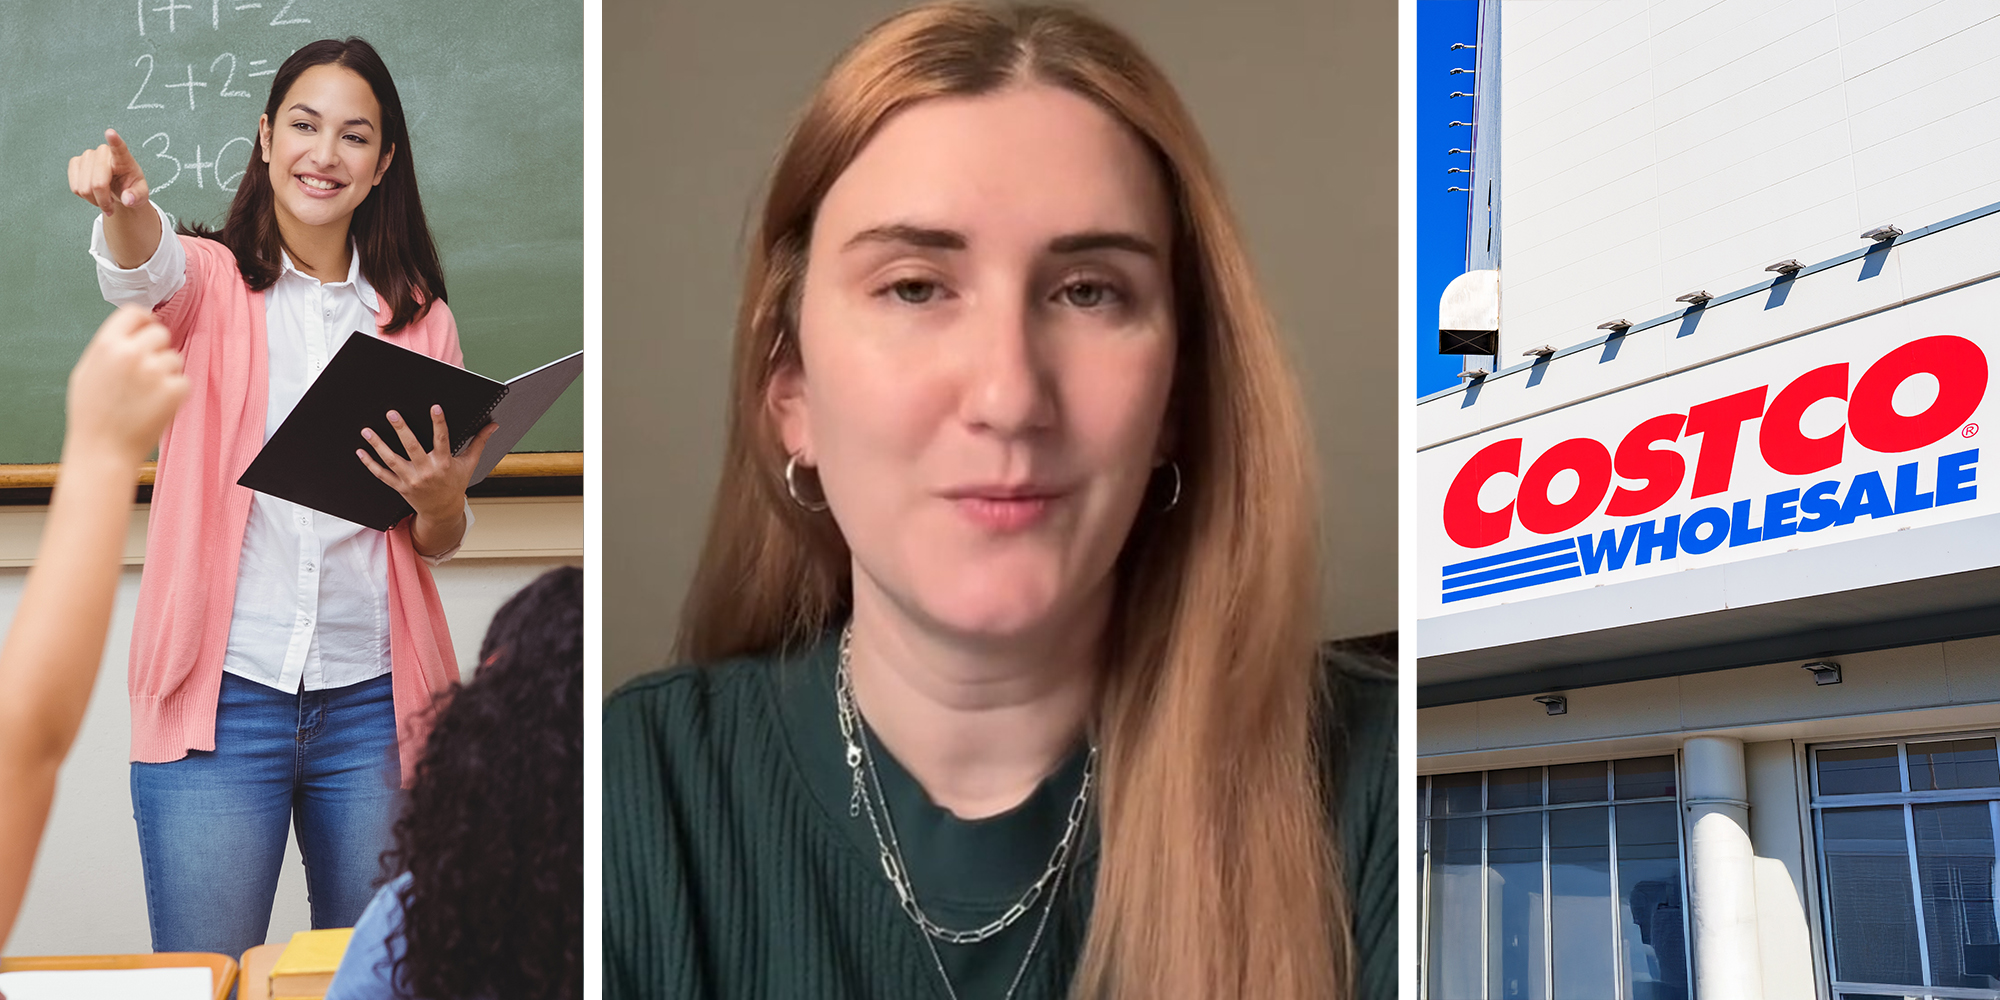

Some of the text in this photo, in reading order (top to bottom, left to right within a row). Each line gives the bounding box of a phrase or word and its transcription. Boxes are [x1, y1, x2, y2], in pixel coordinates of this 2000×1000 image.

[127, 50, 295, 110] 2+2=
[1443, 335, 1989, 549] COSTCO
[1576, 448, 1981, 576] WHOLESALE
